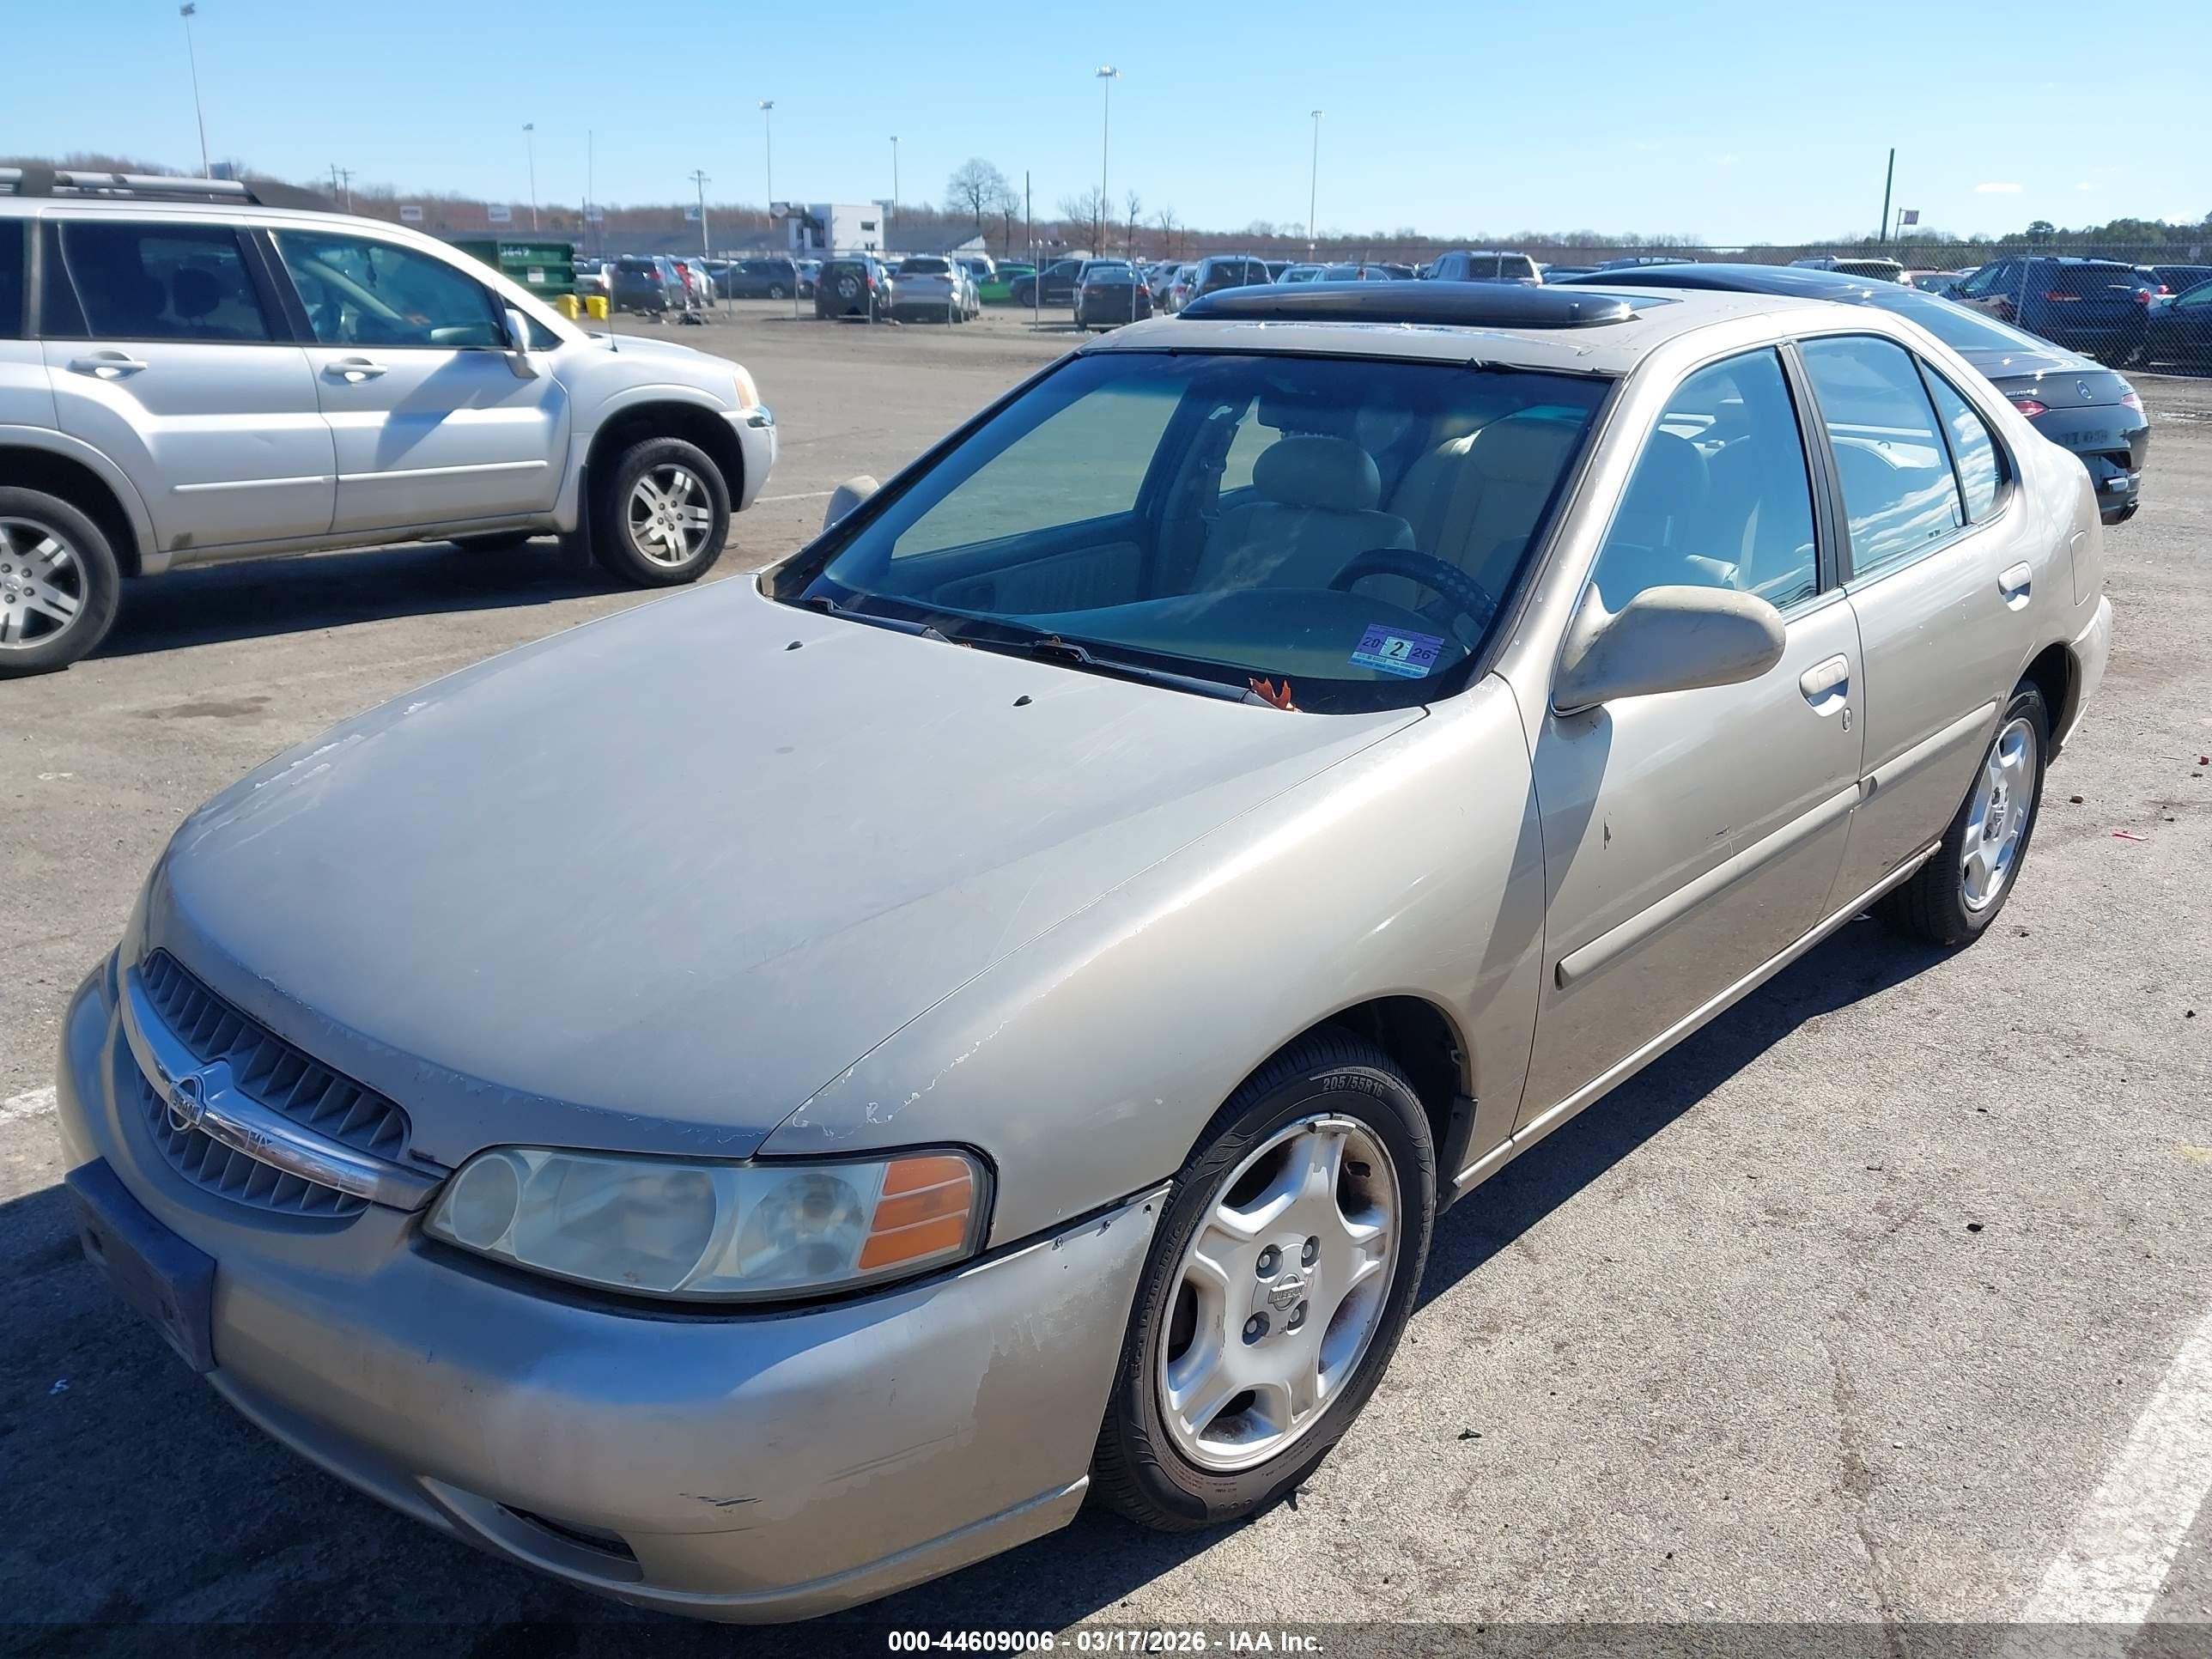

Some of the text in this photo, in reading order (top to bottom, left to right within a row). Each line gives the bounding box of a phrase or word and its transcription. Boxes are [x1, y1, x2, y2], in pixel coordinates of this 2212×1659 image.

[1362, 636, 1431, 659] 20 2 26
[1323, 1075, 1384, 1097] 205/55R16
